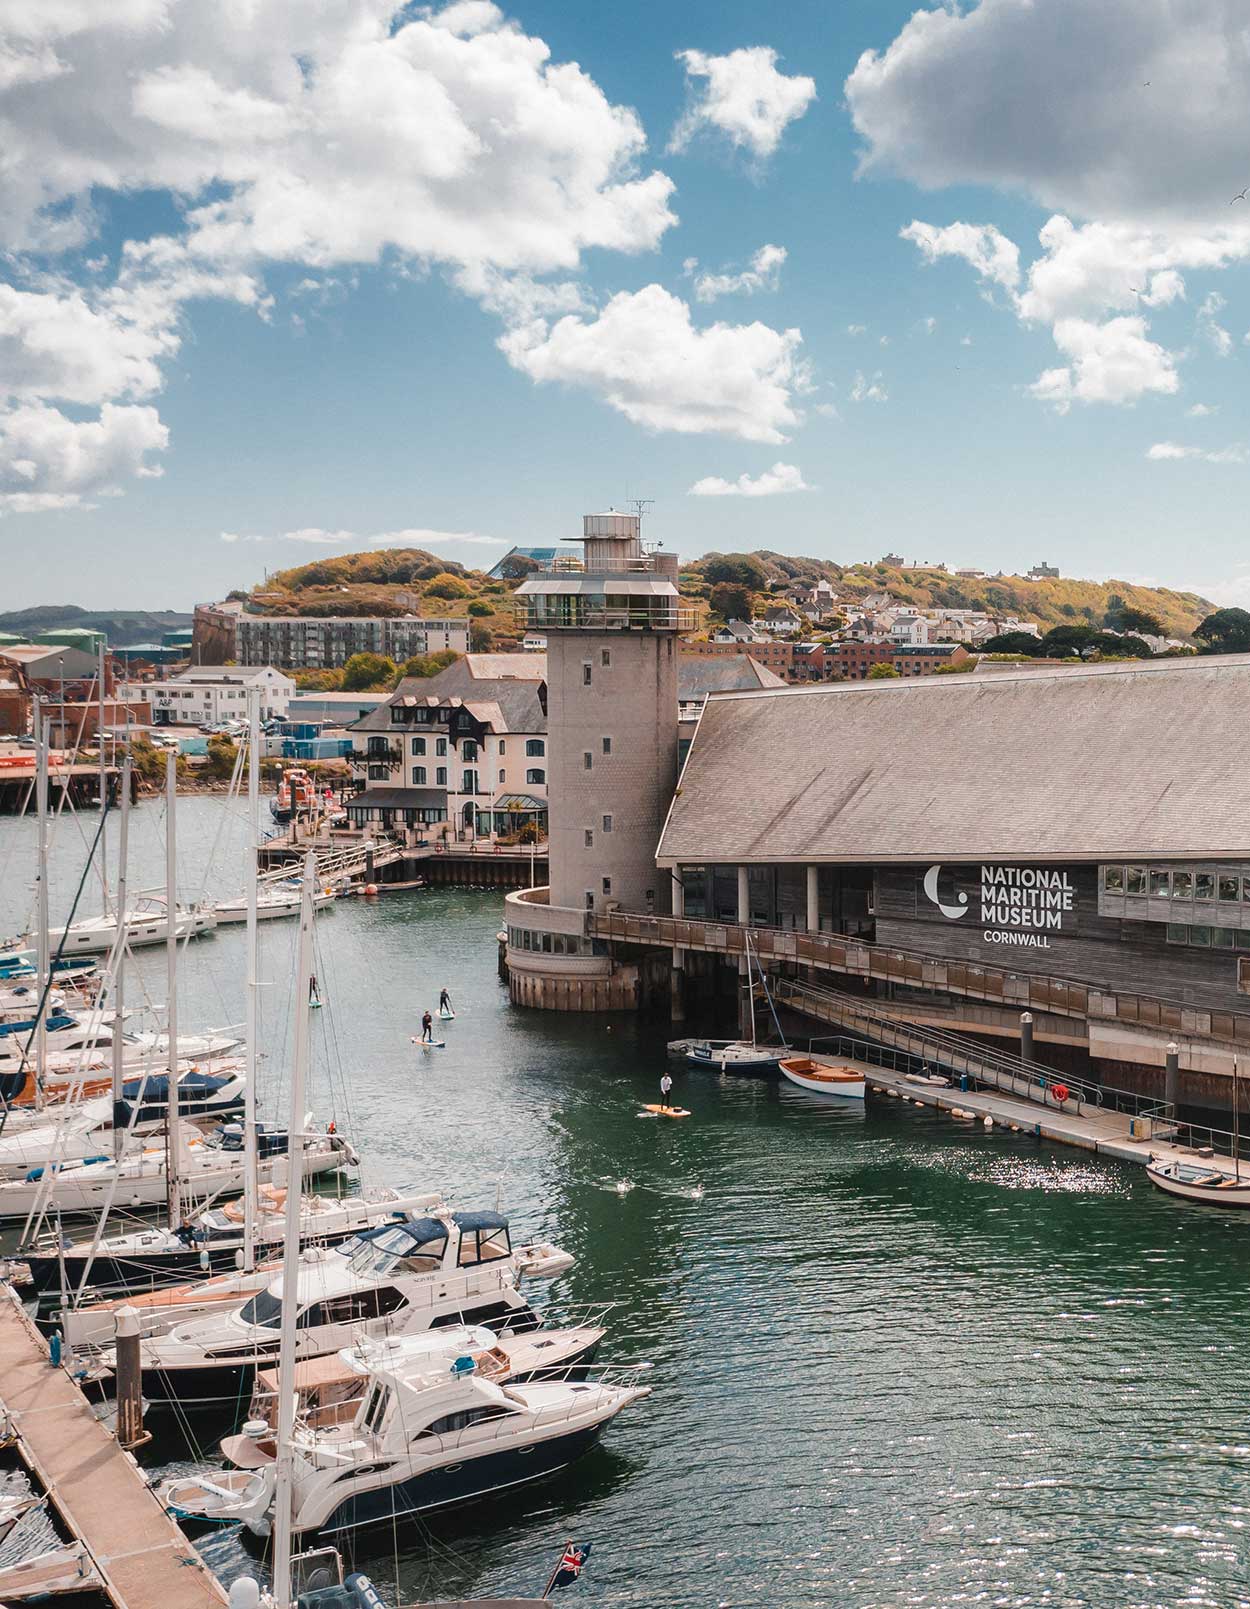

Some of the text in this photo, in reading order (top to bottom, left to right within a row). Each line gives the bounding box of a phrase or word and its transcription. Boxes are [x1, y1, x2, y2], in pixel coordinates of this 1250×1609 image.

[981, 865, 1073, 890] NATIONAL
[981, 885, 1073, 910] MARITIME
[981, 904, 1062, 930] MUSEUM
[983, 930, 1051, 949] CORNWALL
